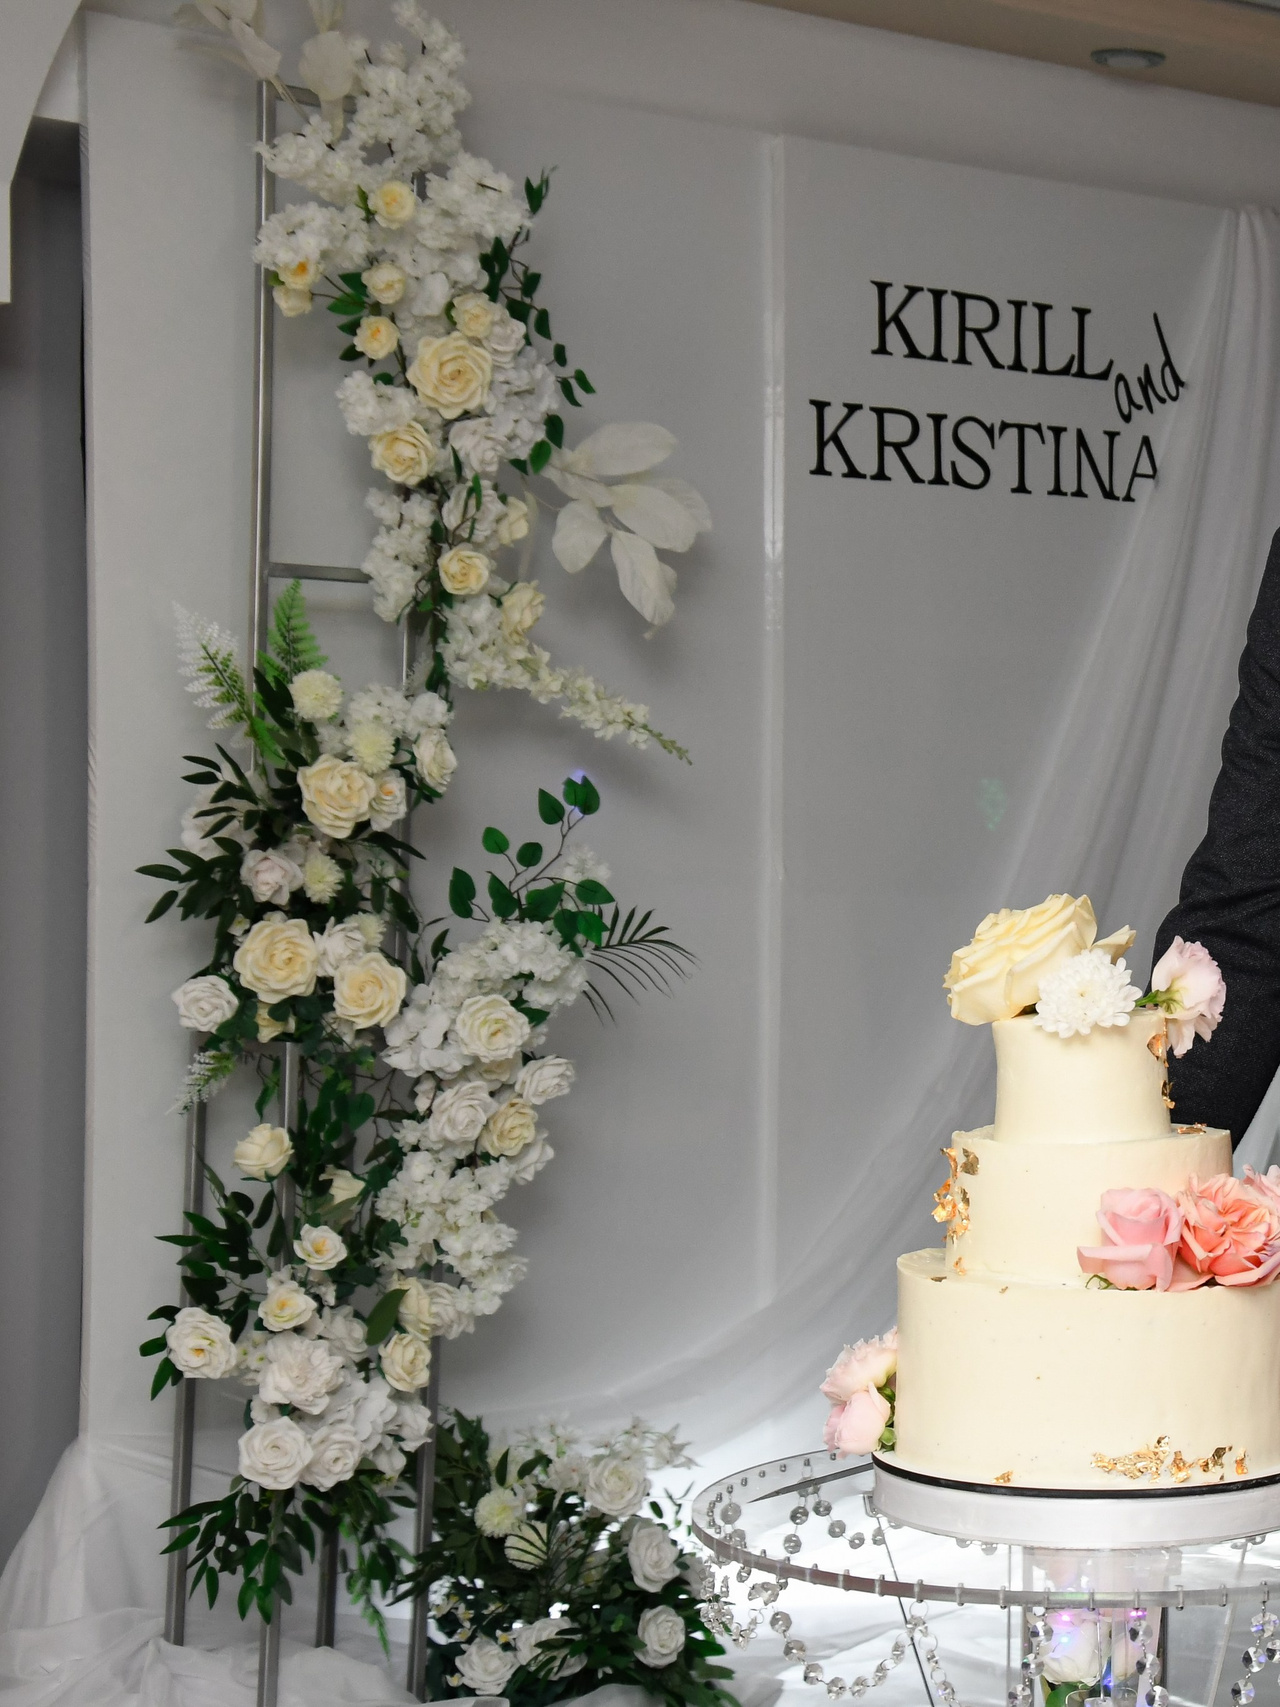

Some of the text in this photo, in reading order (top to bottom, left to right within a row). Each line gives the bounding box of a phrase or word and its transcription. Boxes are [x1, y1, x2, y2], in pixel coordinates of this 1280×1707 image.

[870, 280, 1186, 423] KIRILL and
[808, 399, 1159, 503] KRISTINA
